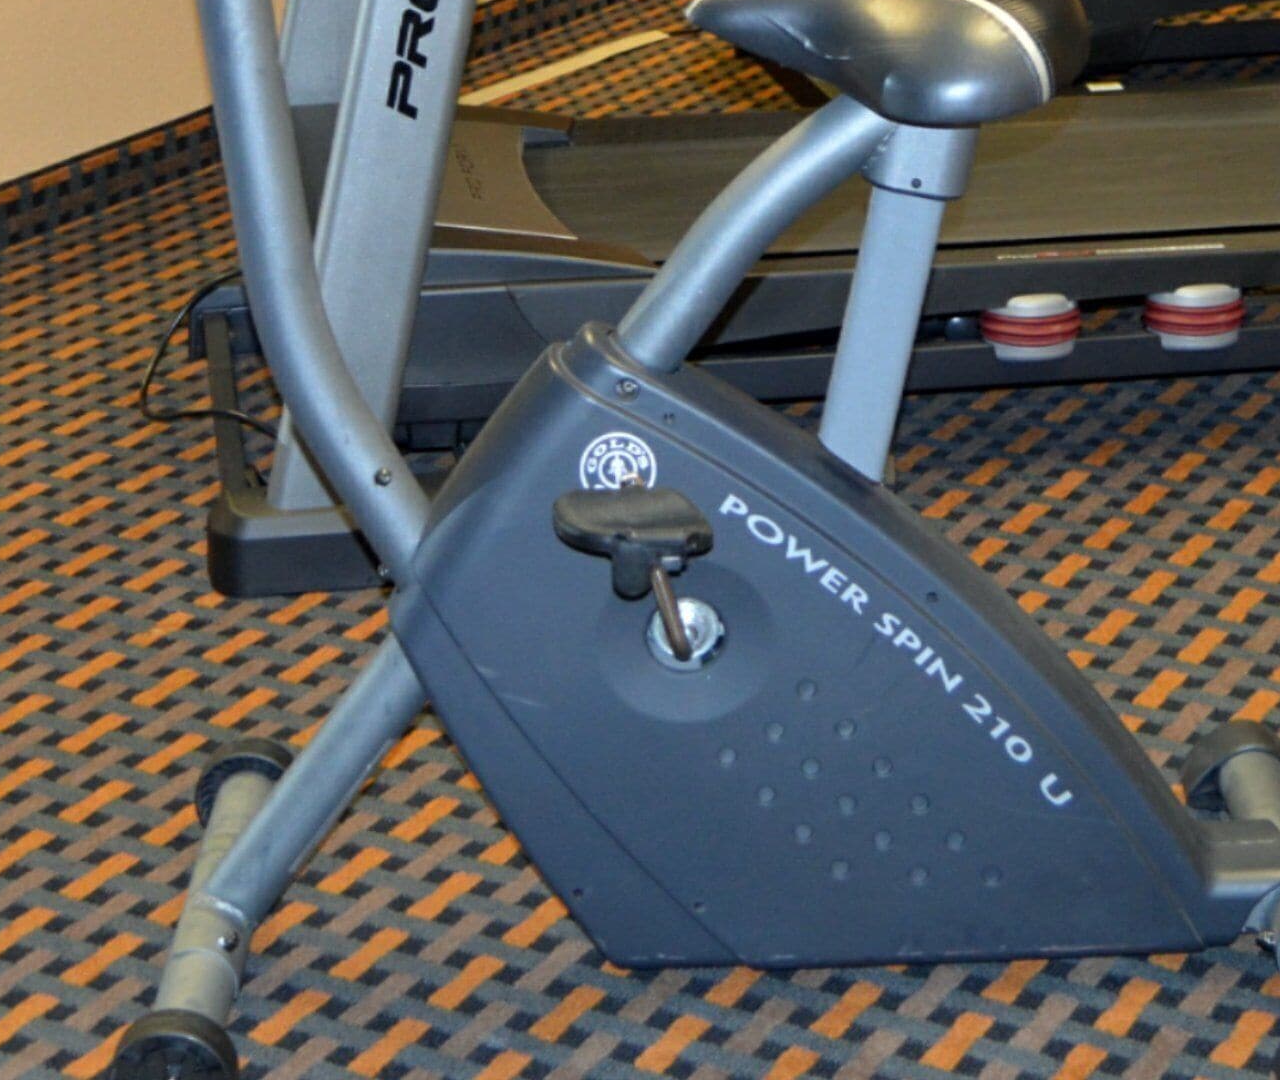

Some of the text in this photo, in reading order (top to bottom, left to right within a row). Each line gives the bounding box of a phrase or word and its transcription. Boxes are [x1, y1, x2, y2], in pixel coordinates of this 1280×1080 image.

[587, 438, 649, 474] GOLD'S
[719, 493, 1073, 807] POWER SPIN 210 U
